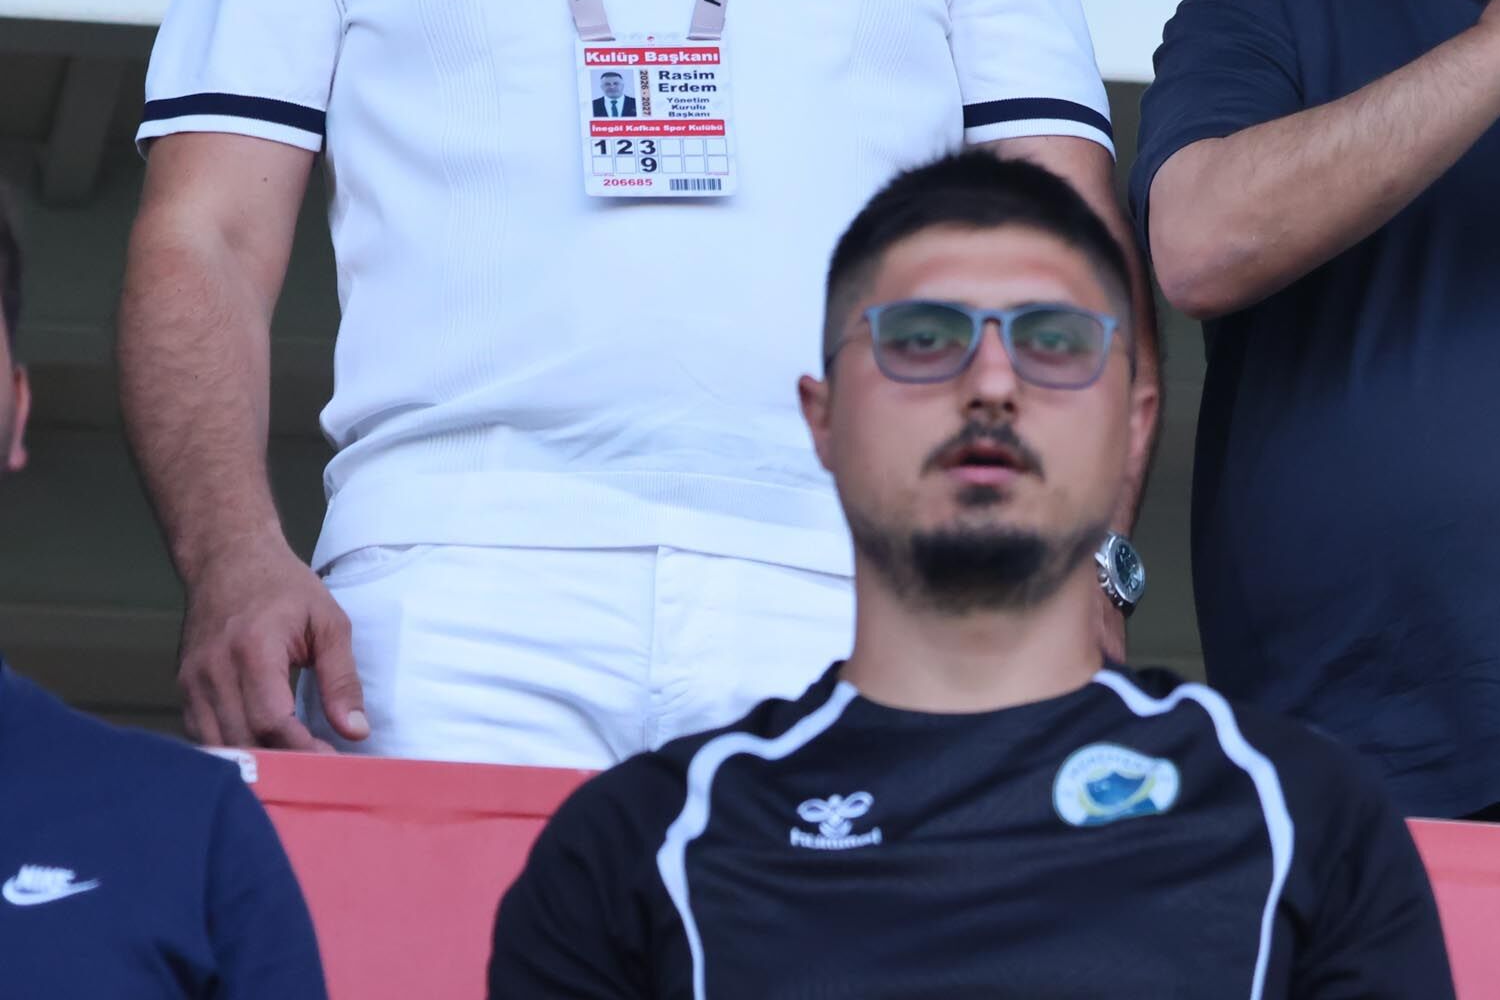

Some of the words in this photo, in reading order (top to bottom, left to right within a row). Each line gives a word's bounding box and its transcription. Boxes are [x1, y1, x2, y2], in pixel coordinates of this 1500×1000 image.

[585, 51, 640, 64] Kulüp
[644, 51, 719, 64] Başkanı
[658, 70, 715, 81] Rasim
[658, 83, 717, 94] Erdem
[666, 96, 710, 104] Yönetim
[663, 124, 685, 133] Spor
[594, 139, 607, 155] 1
[616, 139, 633, 155] 2
[639, 139, 656, 155] 3
[640, 156, 657, 173] 9
[603, 178, 653, 187] 206685
